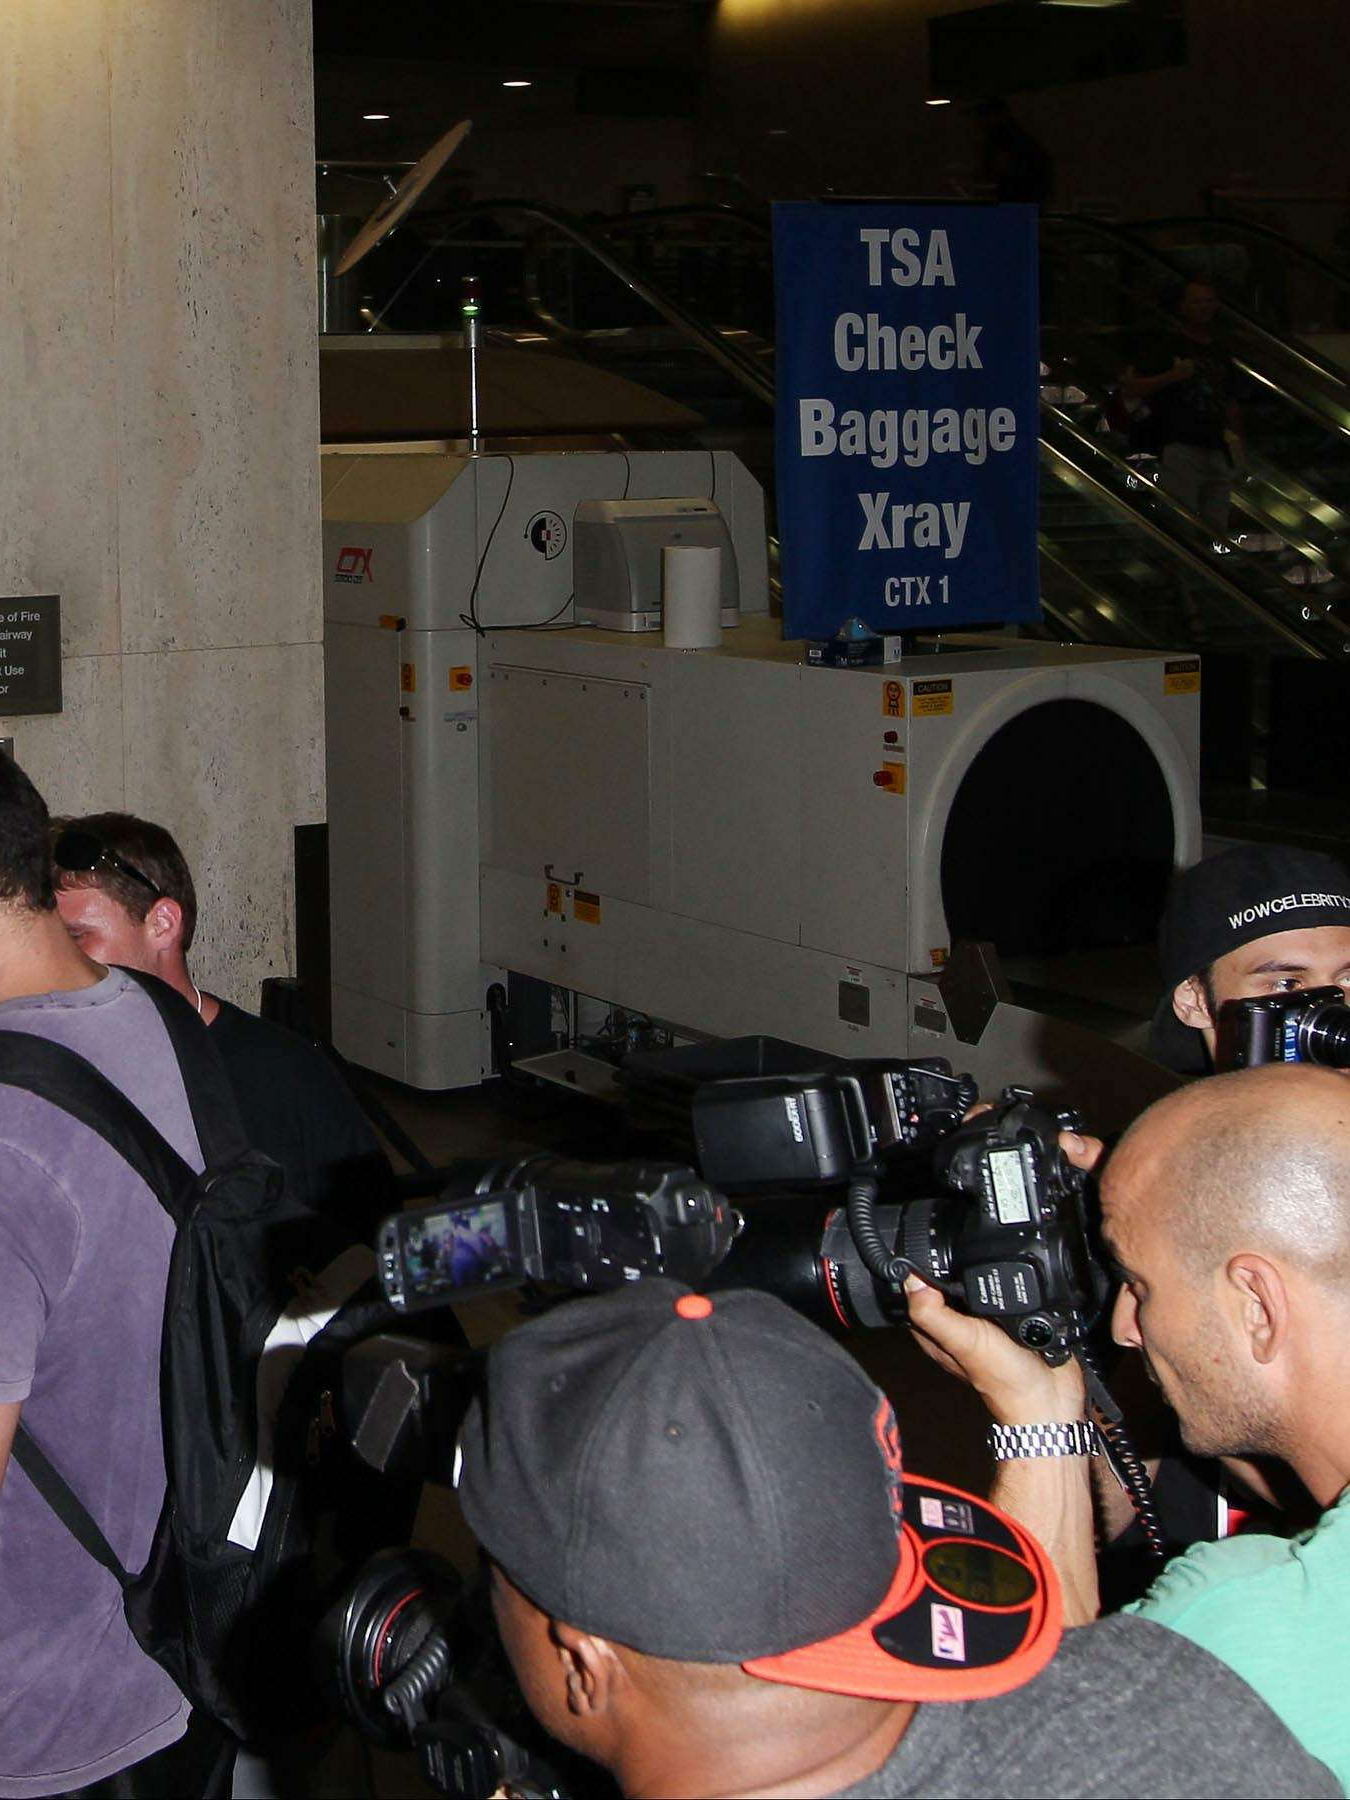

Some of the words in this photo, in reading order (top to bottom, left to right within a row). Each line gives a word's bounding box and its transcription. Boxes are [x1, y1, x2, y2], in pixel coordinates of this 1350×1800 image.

[860, 228, 956, 286] TSA
[834, 312, 983, 372] Check
[799, 398, 1017, 468] Baggage
[857, 491, 971, 559] Xray
[884, 576, 931, 607] CTX
[938, 575, 949, 604] 1
[7, 611, 18, 623] of
[20, 610, 41, 622] Fire
[4, 664, 25, 676] Use
[1228, 893, 1350, 929] WOWCELEBRITY
